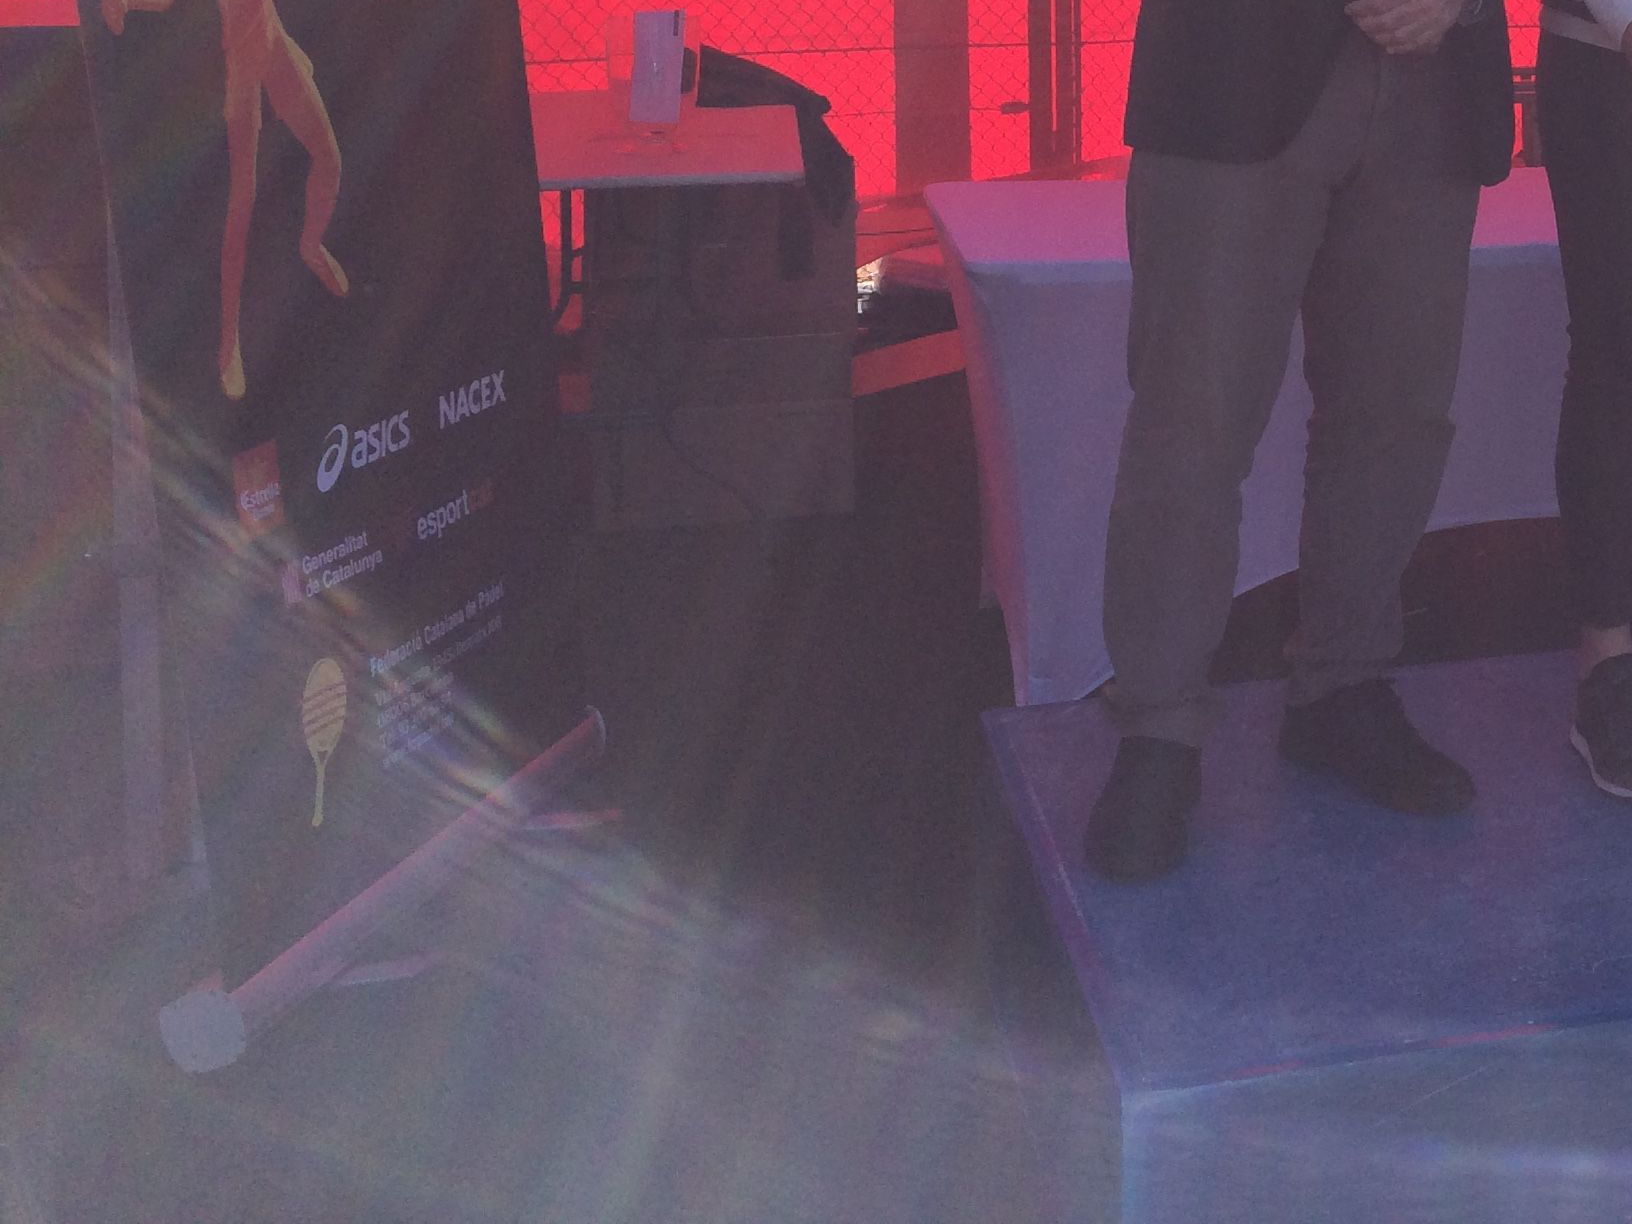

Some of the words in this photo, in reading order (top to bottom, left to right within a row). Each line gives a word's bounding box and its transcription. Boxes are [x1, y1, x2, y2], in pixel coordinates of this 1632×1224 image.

[438, 370, 507, 429] NACEX
[302, 531, 368, 574] Generalitat
[306, 578, 320, 598] de
[322, 548, 383, 588] Catalunya
